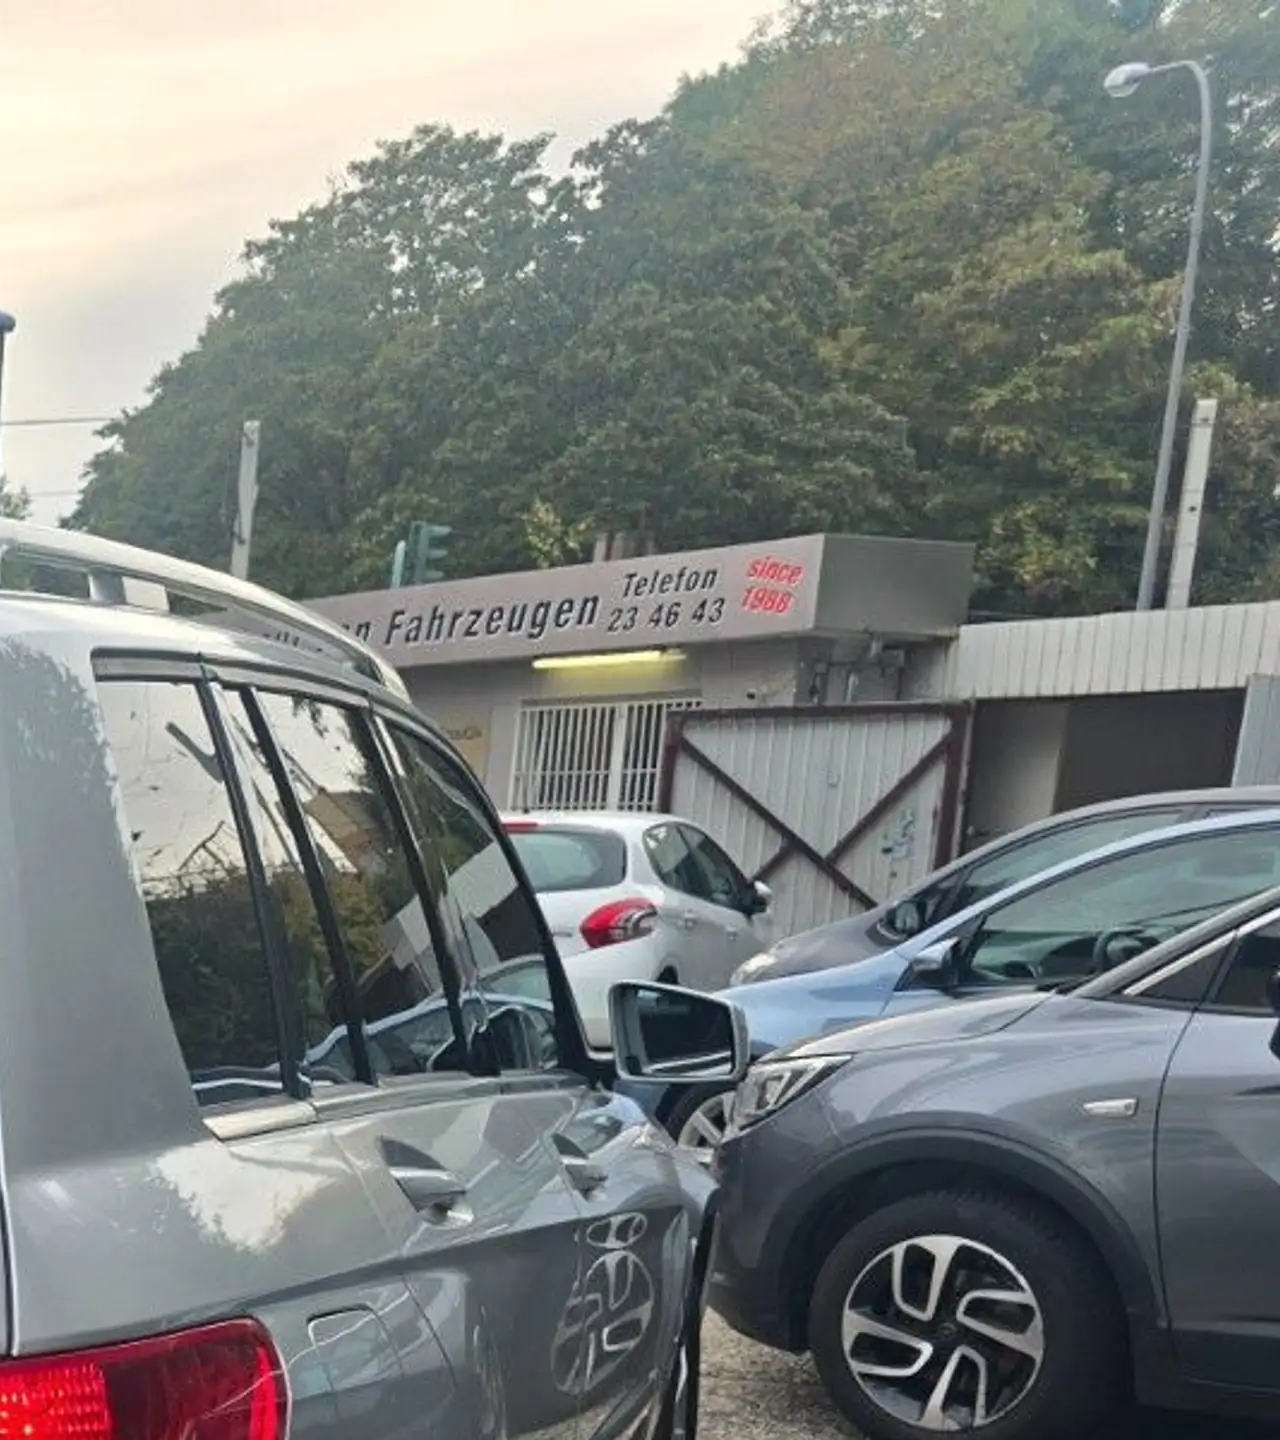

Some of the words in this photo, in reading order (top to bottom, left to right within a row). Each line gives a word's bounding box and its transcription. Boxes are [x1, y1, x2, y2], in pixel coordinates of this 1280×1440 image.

[622, 566, 719, 599] Telefon
[746, 555, 805, 584] since
[385, 595, 601, 645] Fahrzeugen
[607, 606, 640, 634] 23
[648, 601, 682, 628] 46
[691, 597, 727, 624] 43
